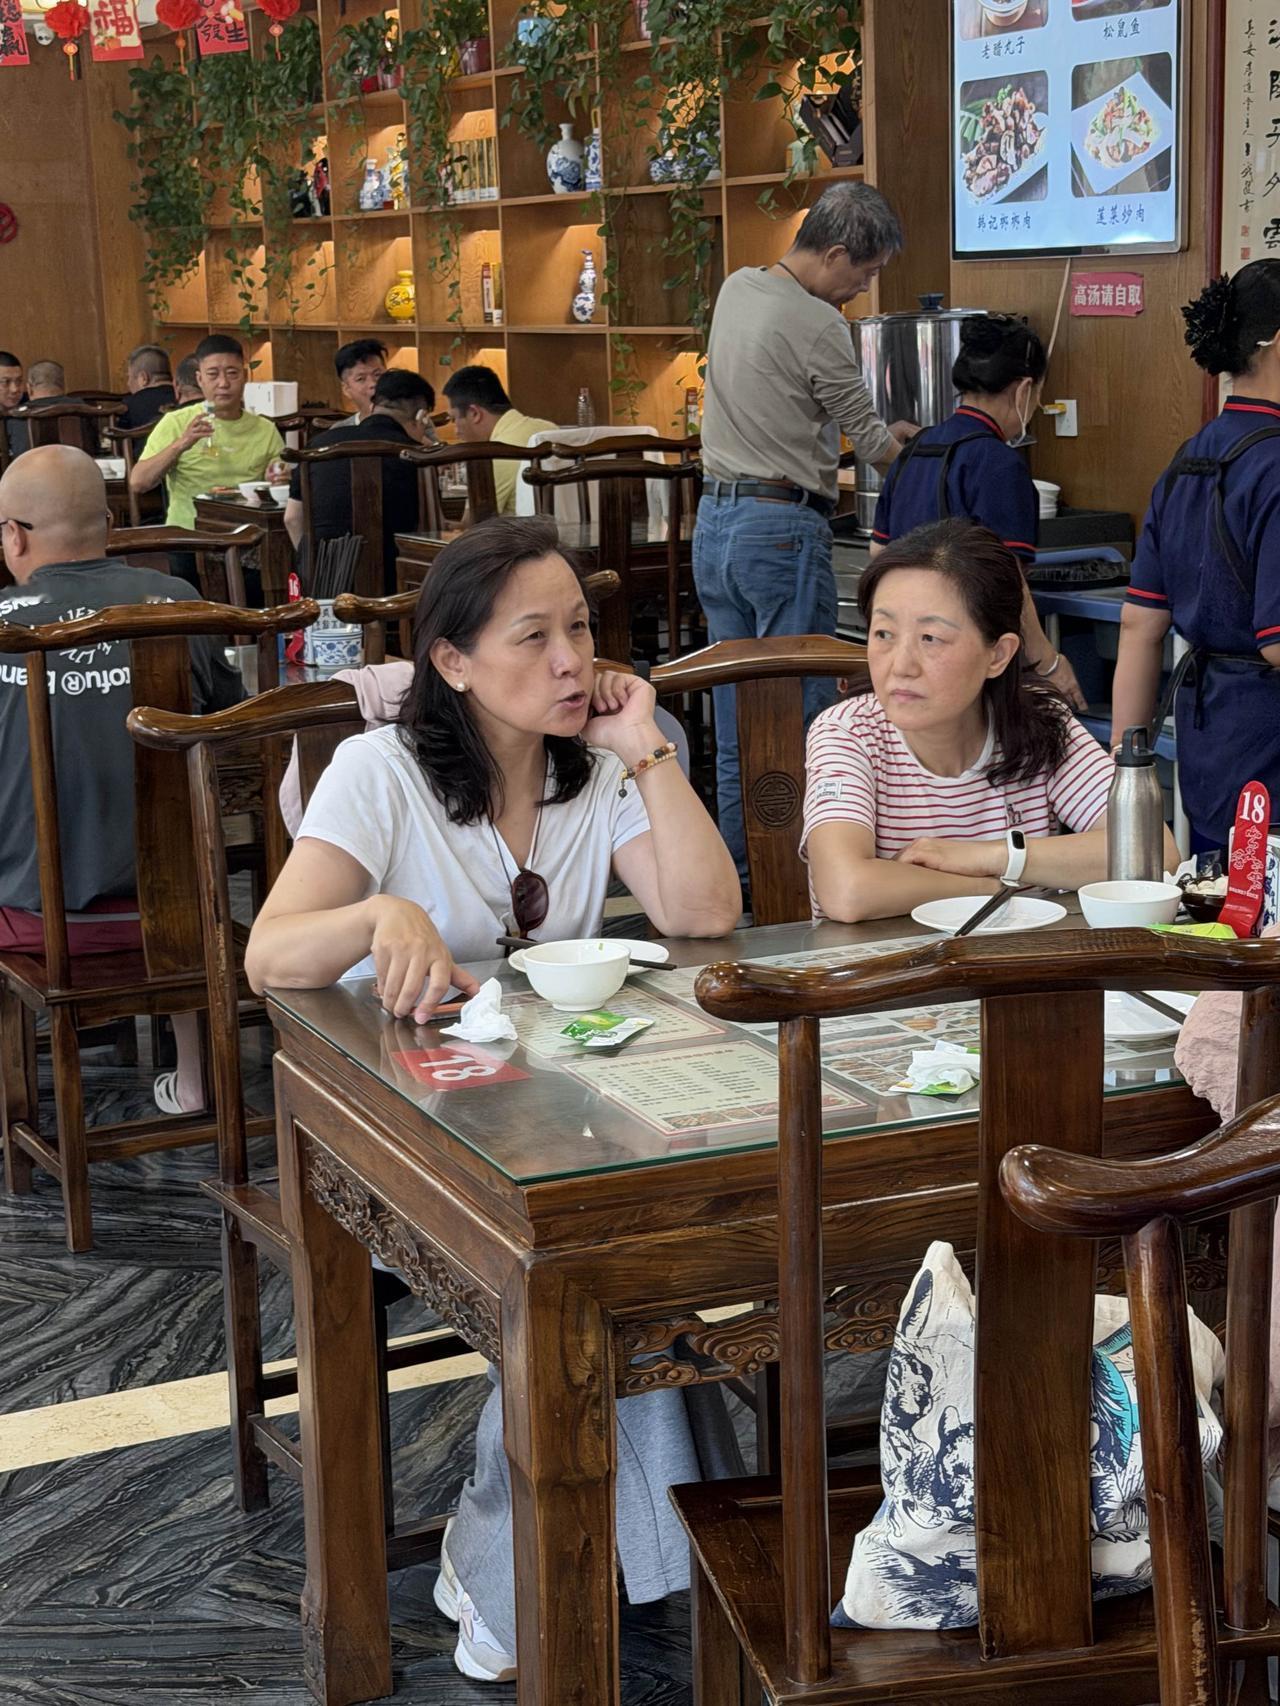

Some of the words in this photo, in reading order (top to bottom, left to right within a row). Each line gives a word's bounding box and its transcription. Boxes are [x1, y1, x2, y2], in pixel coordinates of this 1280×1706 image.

[93, 0, 135, 36] 福
[1074, 283, 1141, 306] 高汤请自取
[1239, 791, 1265, 824] 18
[419, 1054, 497, 1081] 18
